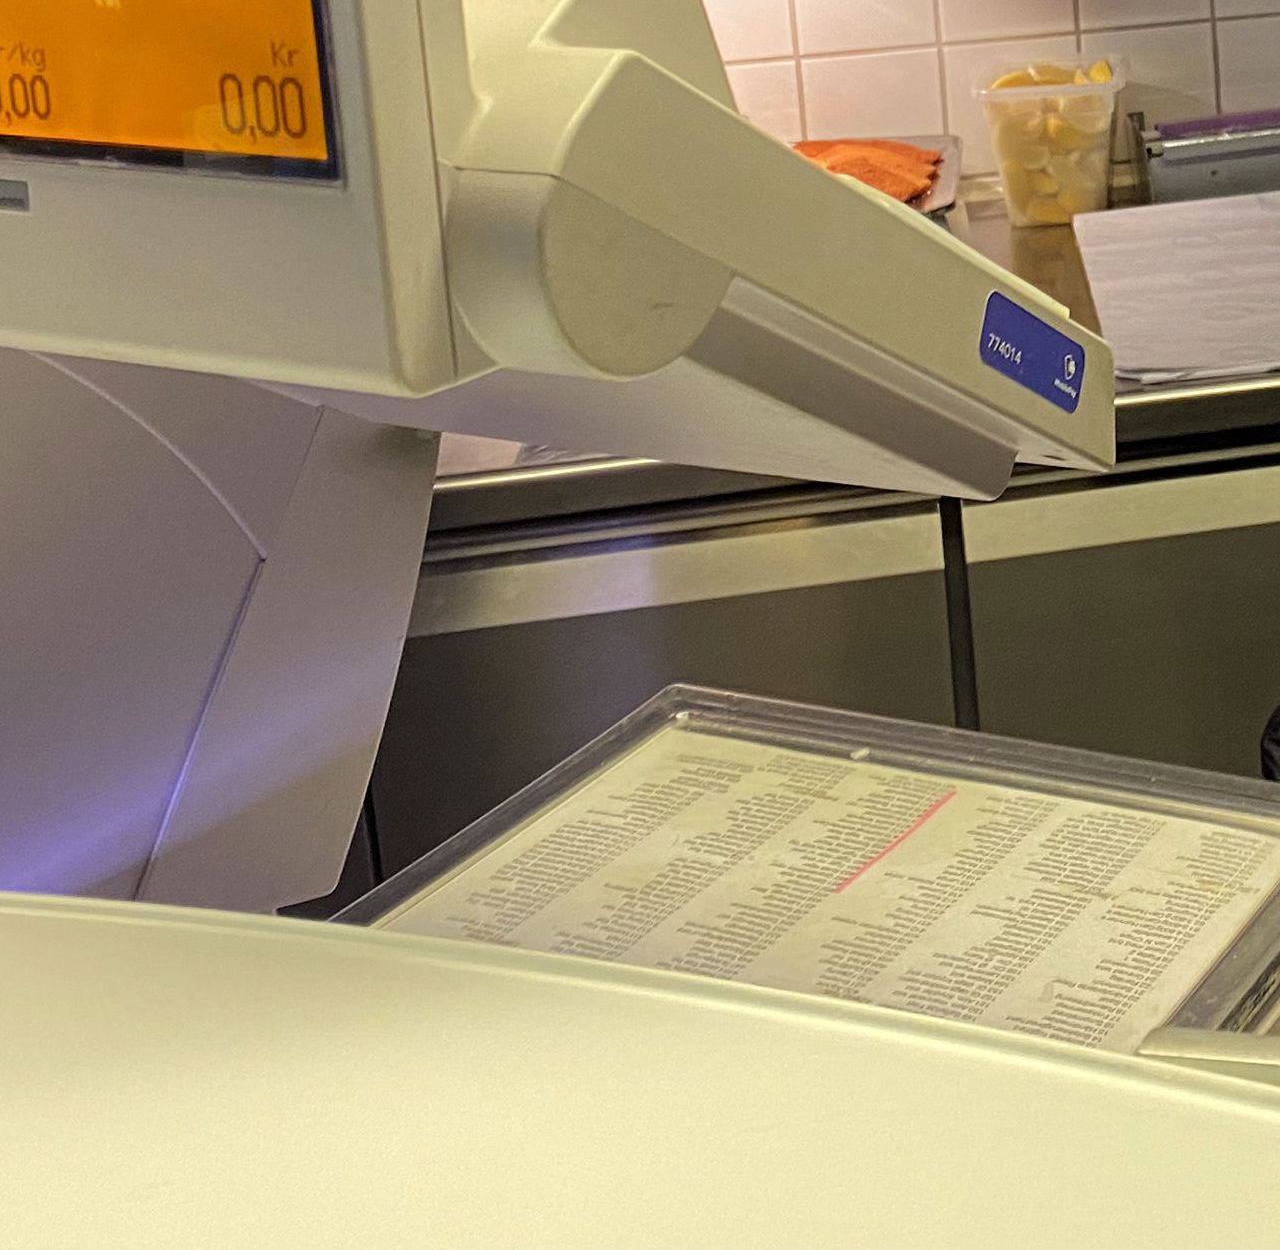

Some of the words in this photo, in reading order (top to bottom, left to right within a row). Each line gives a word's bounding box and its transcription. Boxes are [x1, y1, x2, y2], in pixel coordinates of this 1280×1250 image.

[270, 41, 299, 67] Kr
[0, 73, 51, 127] ,00
[219, 73, 307, 143] 0,00
[987, 332, 1022, 365] 774014
